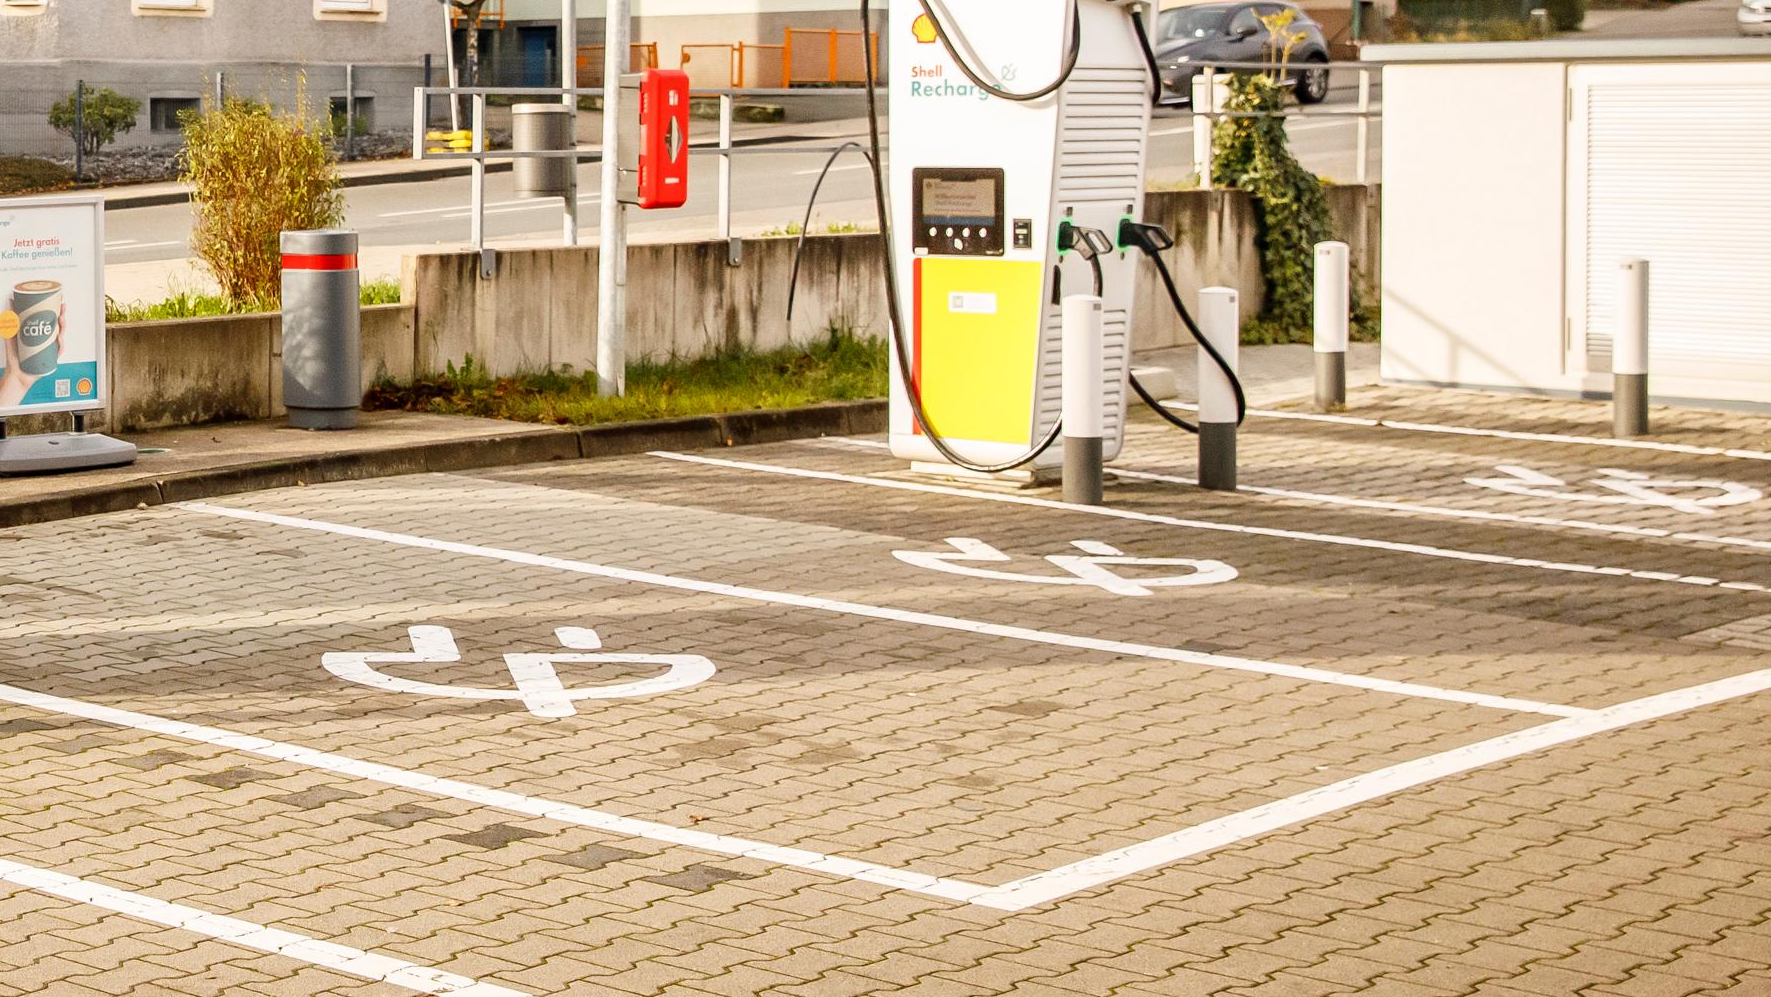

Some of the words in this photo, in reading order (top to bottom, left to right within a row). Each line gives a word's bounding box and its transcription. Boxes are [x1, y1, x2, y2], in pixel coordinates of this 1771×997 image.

[911, 65, 943, 78] Shell
[14, 238, 34, 248] Jetzt
[36, 237, 60, 248] gratis
[1, 248, 30, 260] Kaffee
[31, 247, 73, 260] genießen!
[23, 321, 52, 337] café
